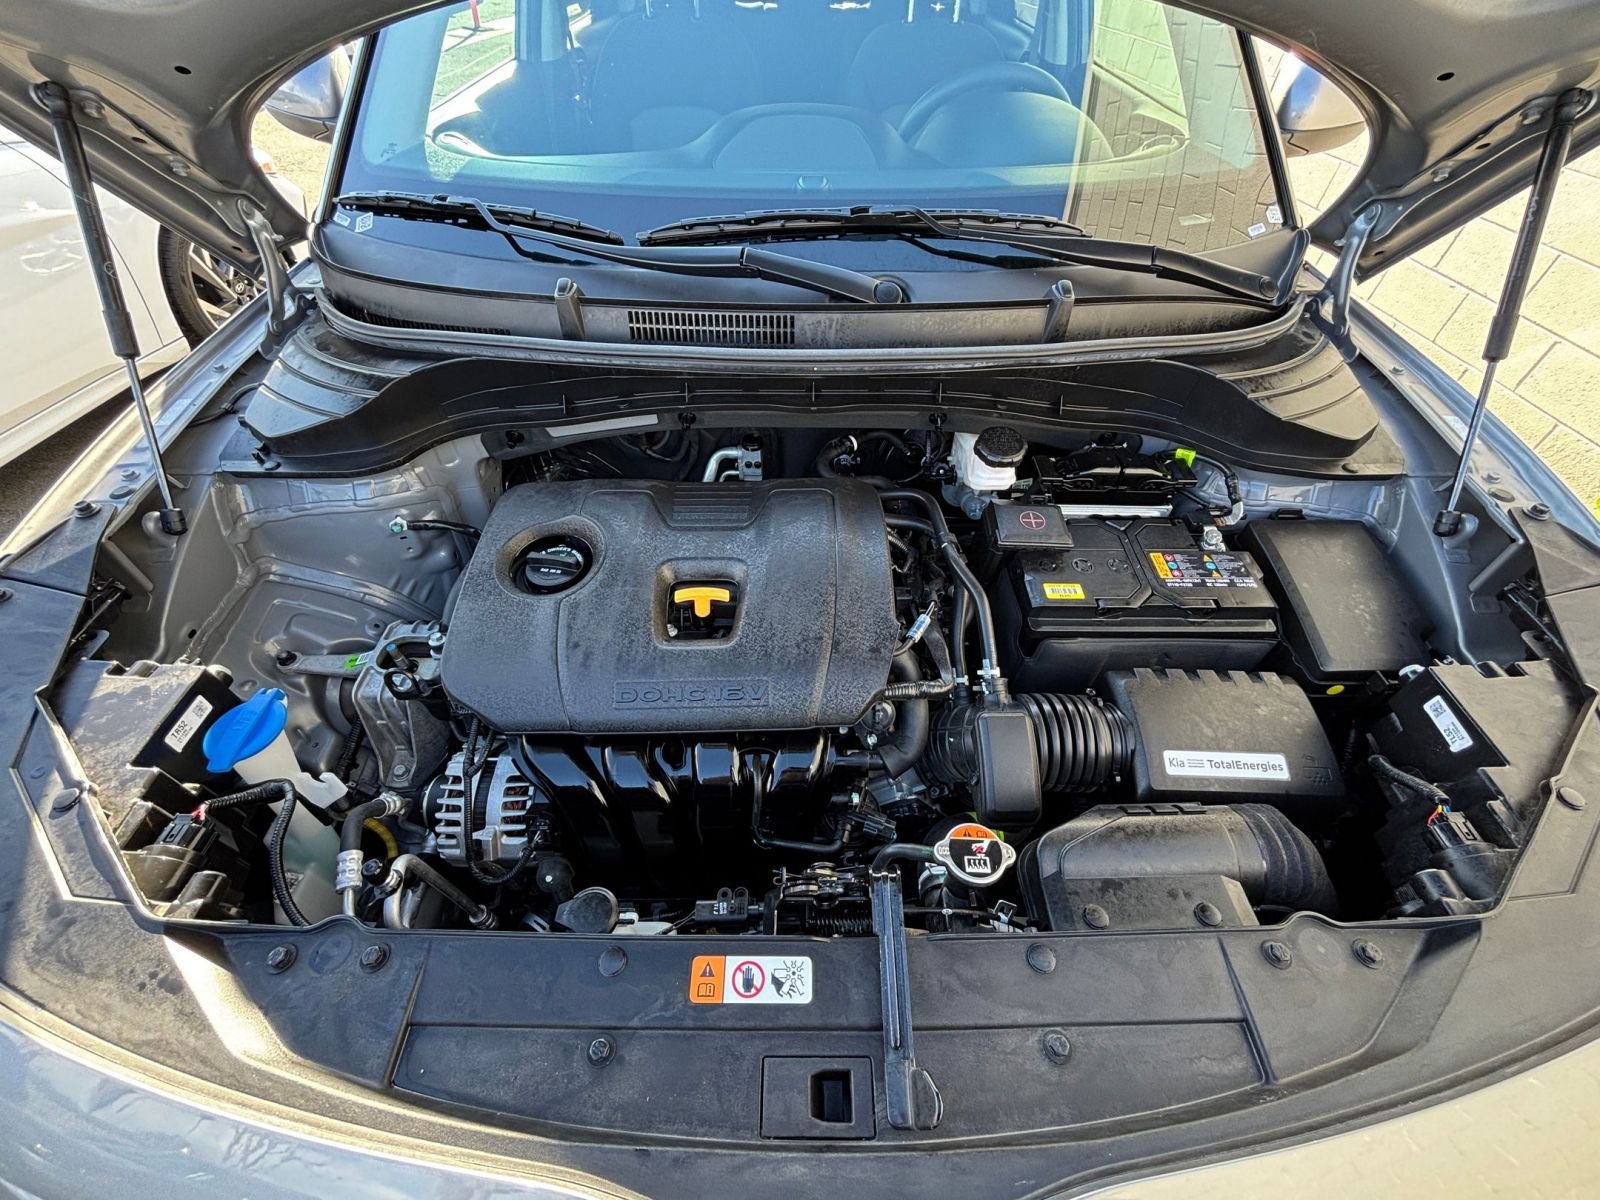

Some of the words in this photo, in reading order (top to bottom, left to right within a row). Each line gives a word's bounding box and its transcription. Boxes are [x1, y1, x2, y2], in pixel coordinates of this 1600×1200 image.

[615, 687, 705, 703] DOHC
[714, 684, 767, 701] 16V
[1168, 757, 1186, 768] Kia
[1207, 759, 1284, 773] TotalEnergies
